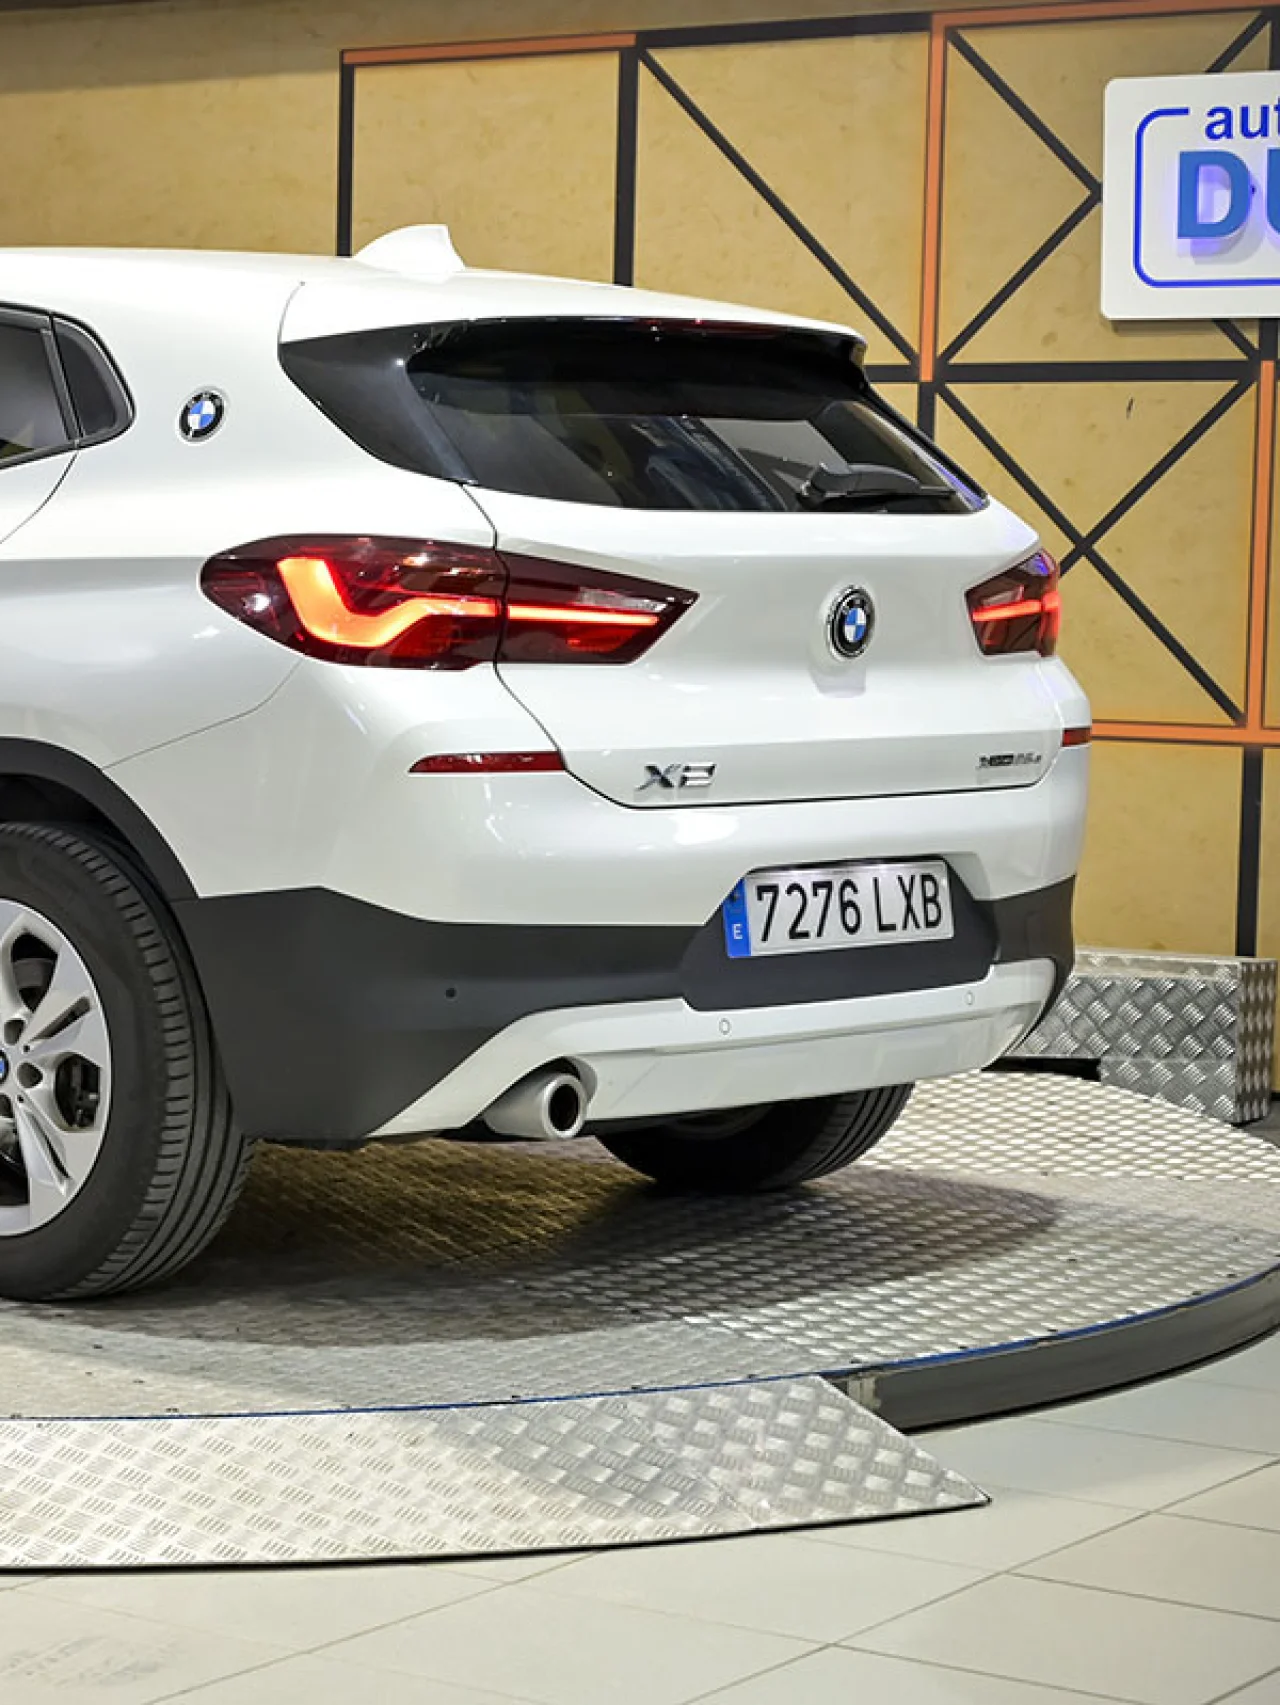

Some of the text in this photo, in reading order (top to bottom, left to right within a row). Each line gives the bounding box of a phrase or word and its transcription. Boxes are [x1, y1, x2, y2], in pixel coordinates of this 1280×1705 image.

[1177, 148, 1280, 239] D
[634, 763, 716, 791] X2
[733, 923, 743, 939] E
[756, 873, 941, 942] 7276 LXB
